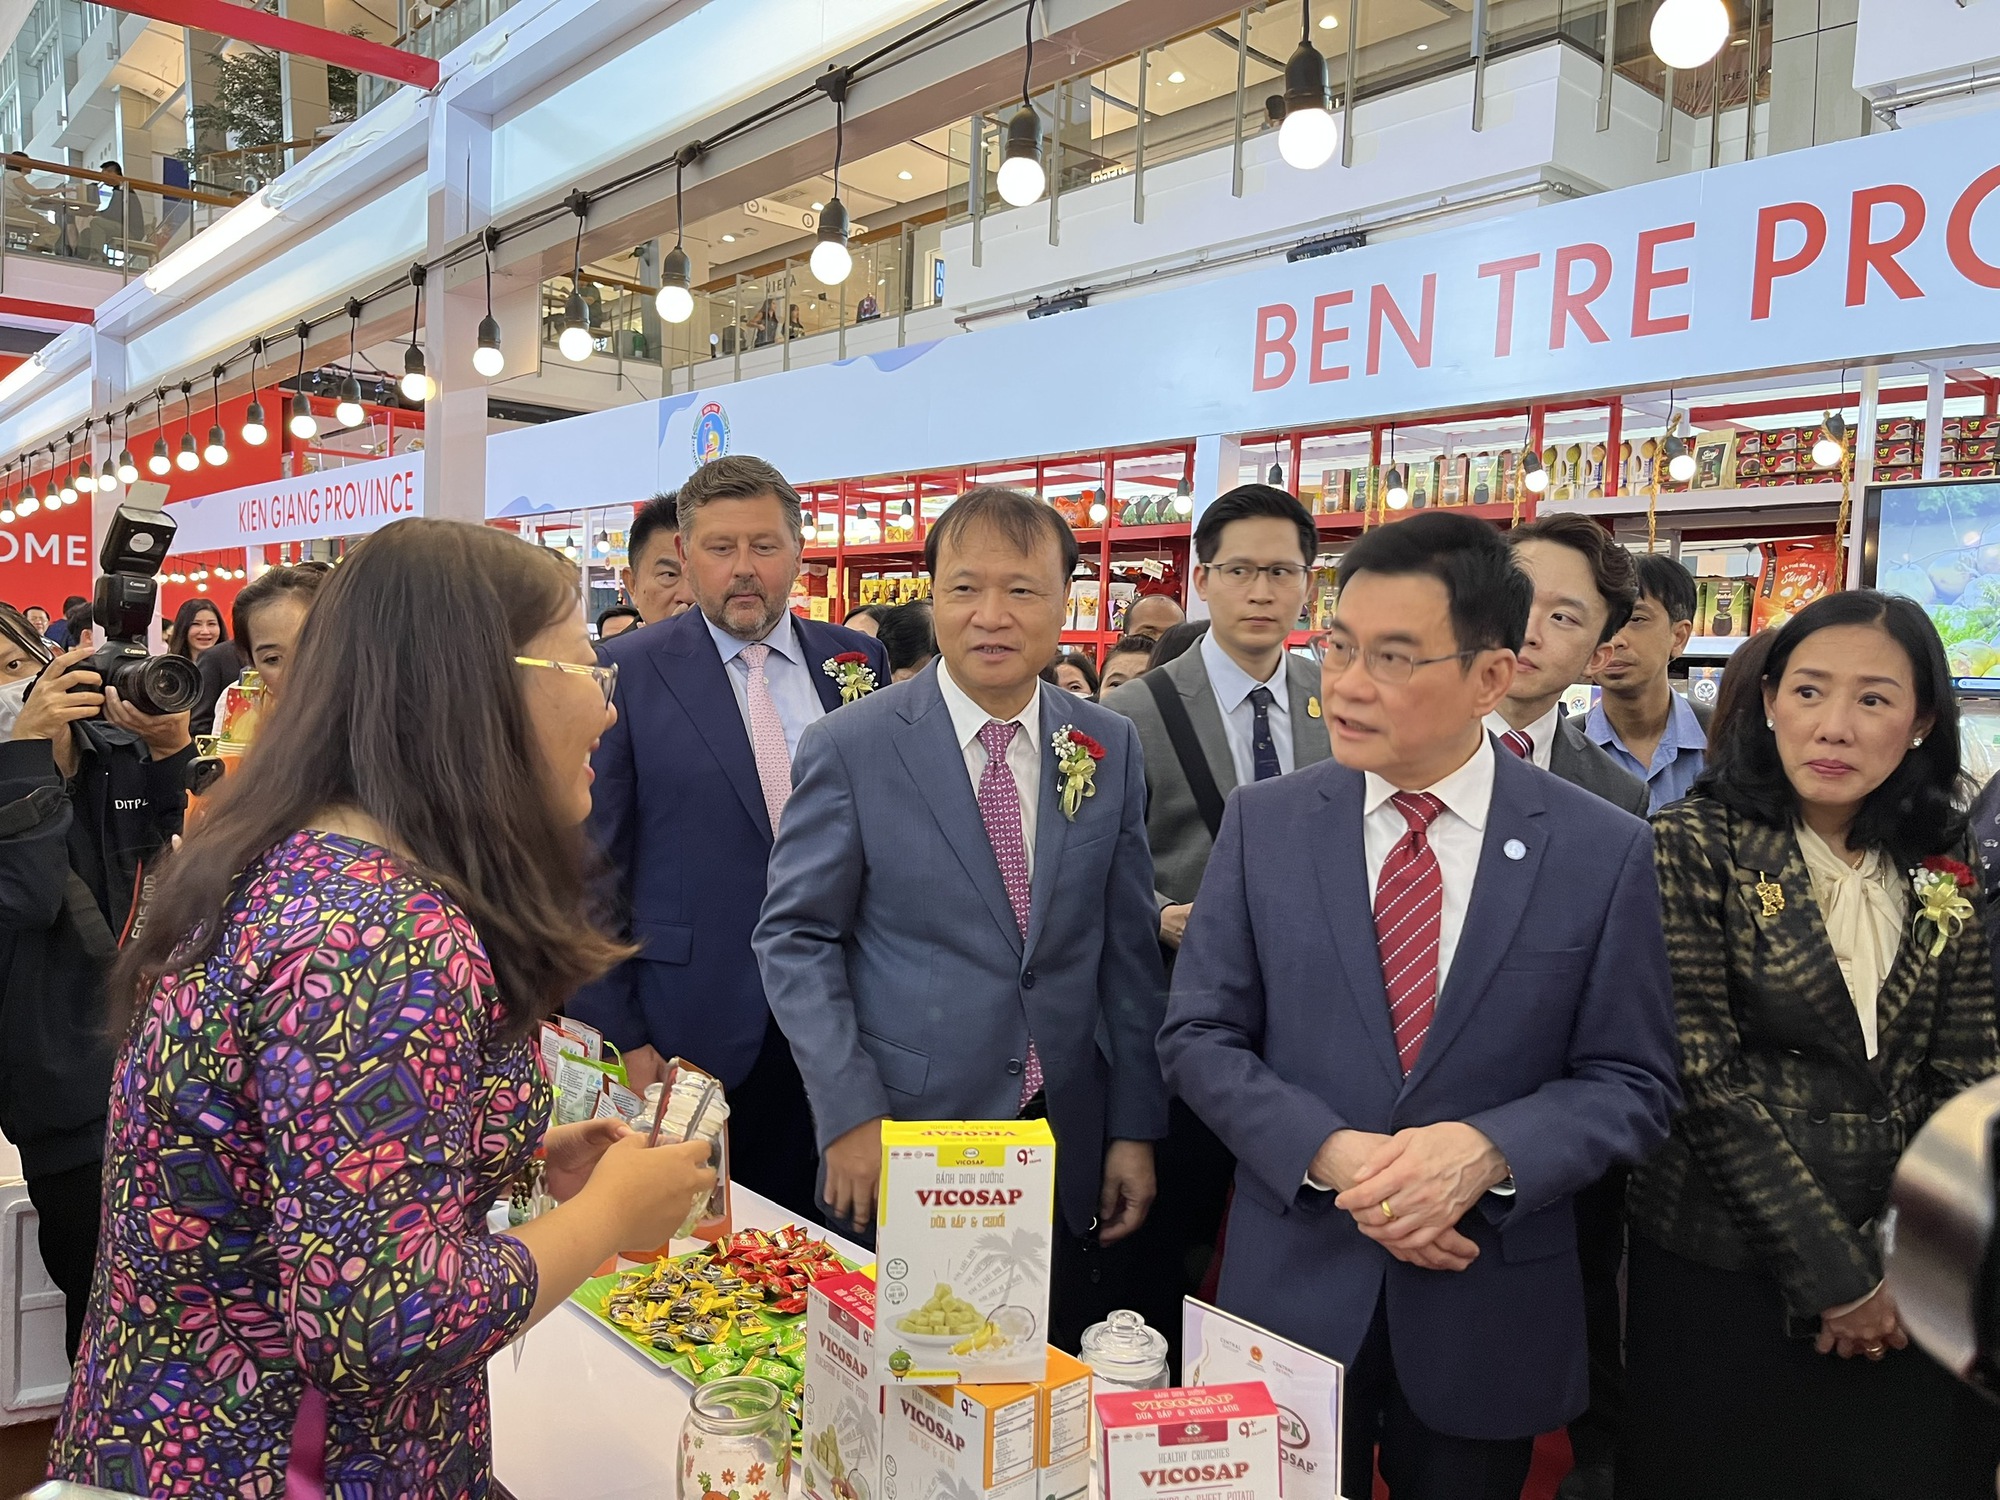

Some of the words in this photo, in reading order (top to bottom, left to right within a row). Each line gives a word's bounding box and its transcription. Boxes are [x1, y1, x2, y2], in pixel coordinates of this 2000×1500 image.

[1252, 272, 1436, 393] BEN
[1478, 221, 1695, 357] TRE
[238, 501, 268, 533] KIEN
[271, 489, 319, 528] GIANG
[325, 471, 414, 523] PROVINCE
[124, 647, 147, 655] Canon
[935, 1171, 955, 1185] BÁNH
[959, 1173, 976, 1185] DINH
[915, 1188, 1023, 1207] VICOSAP
[971, 1215, 978, 1228] &
[818, 1330, 868, 1380] VICOSAP
[1132, 1392, 1234, 1412] VICOSAP
[1135, 1410, 1153, 1421] DỪA
[1157, 1408, 1173, 1419] SÁP
[1189, 1405, 1215, 1416] KHOAI
[1218, 1402, 1240, 1413] LANG
[900, 1398, 965, 1452] VICOSAP
[1158, 1450, 1187, 1464] HEALTHY
[1191, 1447, 1230, 1463] CRUNCHIES
[1139, 1462, 1250, 1488] VICOSAP
